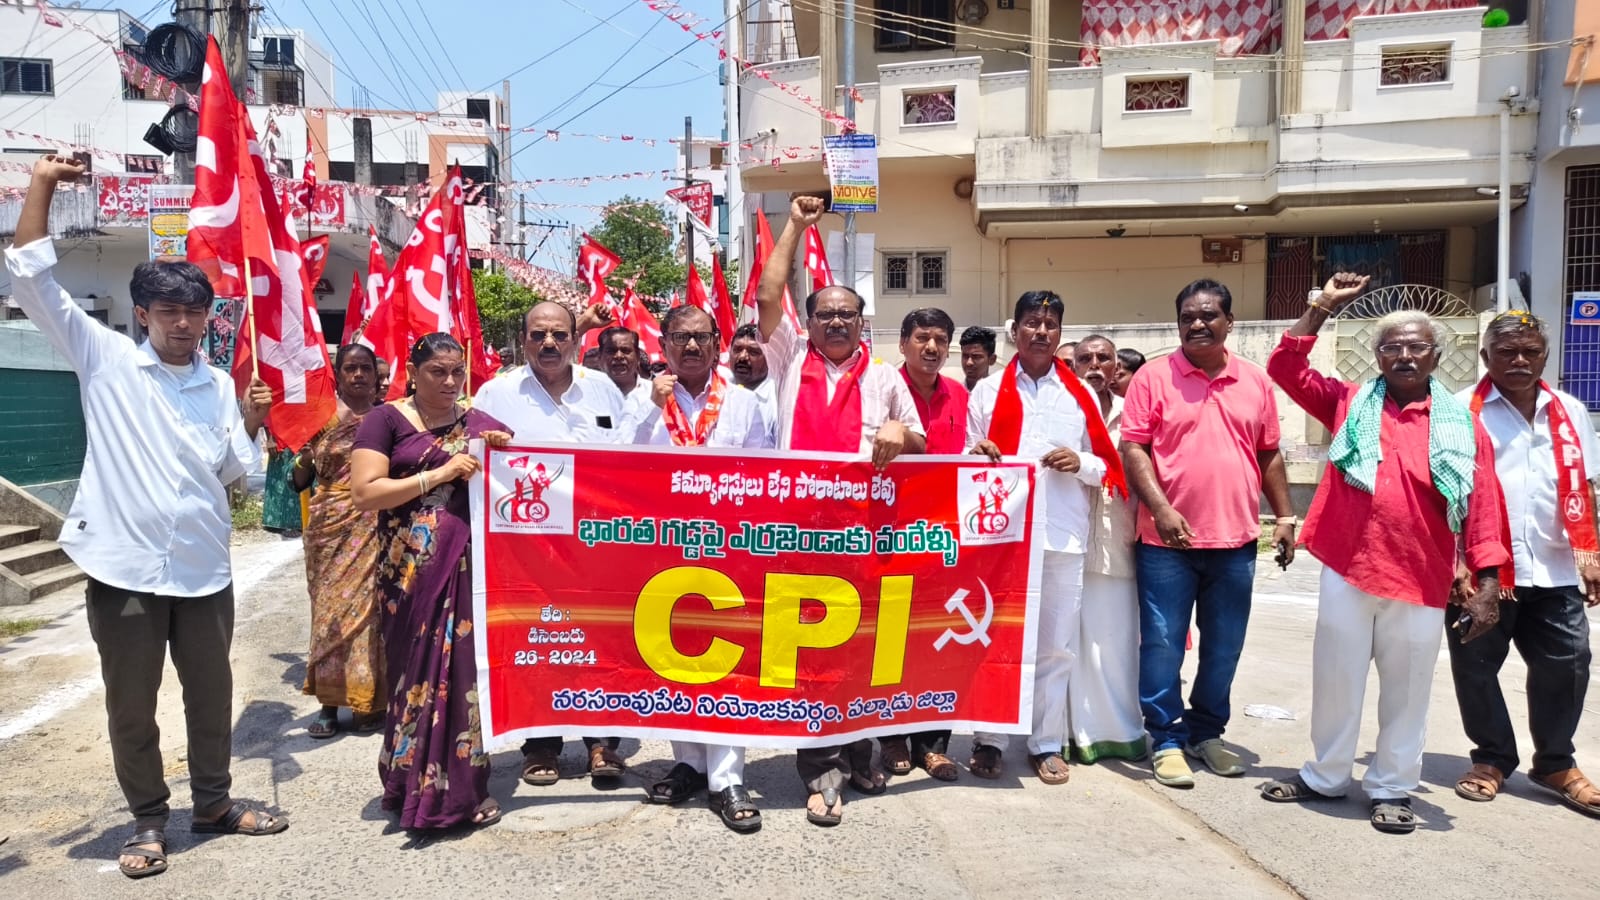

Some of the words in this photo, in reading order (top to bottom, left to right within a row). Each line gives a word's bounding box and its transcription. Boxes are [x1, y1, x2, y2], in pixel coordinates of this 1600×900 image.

[154, 198, 192, 206] SUMMER
[834, 186, 876, 198] MOTIVE
[1558, 420, 1582, 491] CPI
[671, 470, 763, 505] కమ్యూనిస్టులు
[768, 471, 791, 503] లేని
[795, 471, 868, 501] పోరాటాలు
[871, 472, 896, 506] లేవు
[579, 517, 655, 547] భారత
[661, 519, 726, 559] గడ్డపై
[729, 522, 871, 557] ఎర్రజెండాకు
[541, 604, 563, 622] తేది
[528, 627, 585, 644] డిసెంబరు
[633, 566, 914, 688] CPI
[548, 650, 597, 665] 2024
[553, 688, 692, 718] నరసరావుపేట
[697, 694, 842, 731] నియోజకవర్గం,
[848, 694, 914, 719] పల్నాడు
[917, 690, 957, 712] జిల్లా
